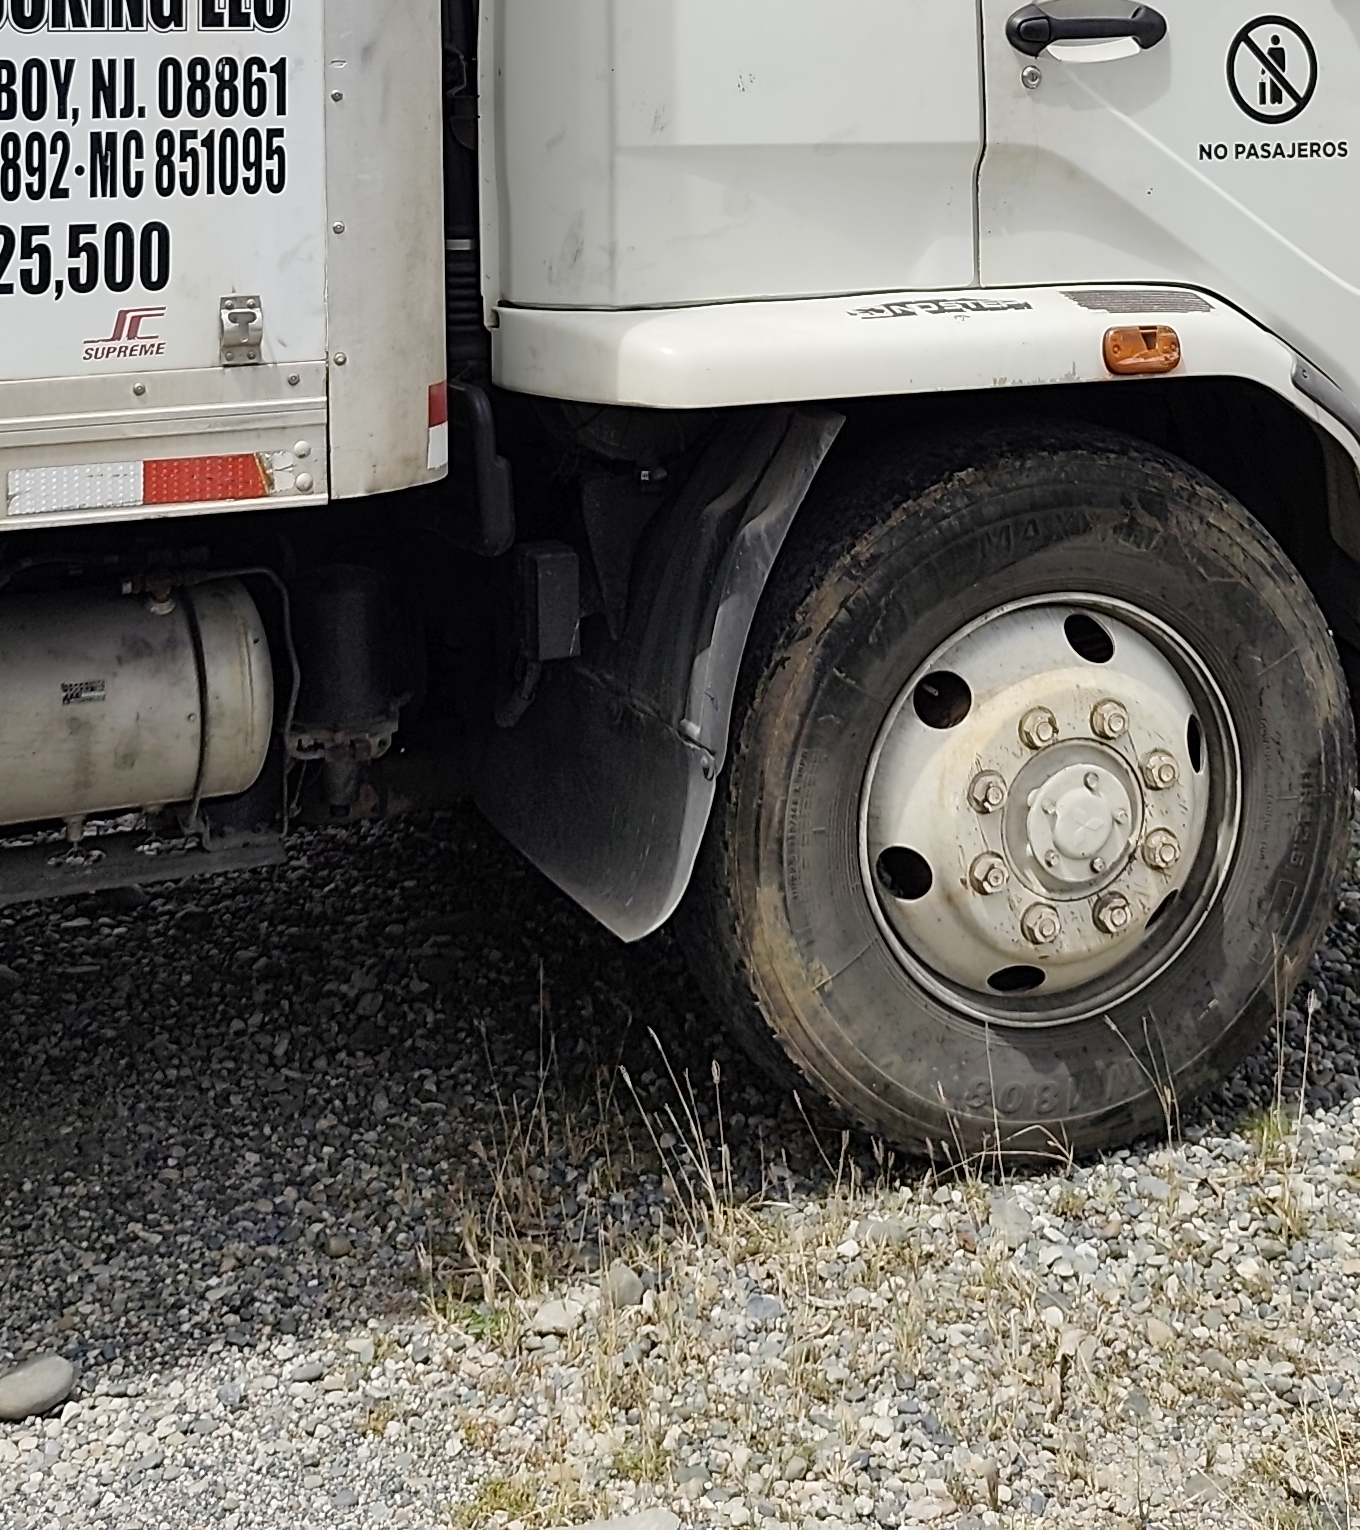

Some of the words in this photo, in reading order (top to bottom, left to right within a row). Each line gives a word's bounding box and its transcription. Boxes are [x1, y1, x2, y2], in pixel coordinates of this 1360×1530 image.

[92, 58, 146, 119] NJ.
[158, 56, 287, 118] 08861
[155, 127, 286, 198] 851095
[1198, 143, 1228, 161] NO
[1234, 141, 1348, 160] PASAJEROS
[83, 342, 166, 360] SUPREME
